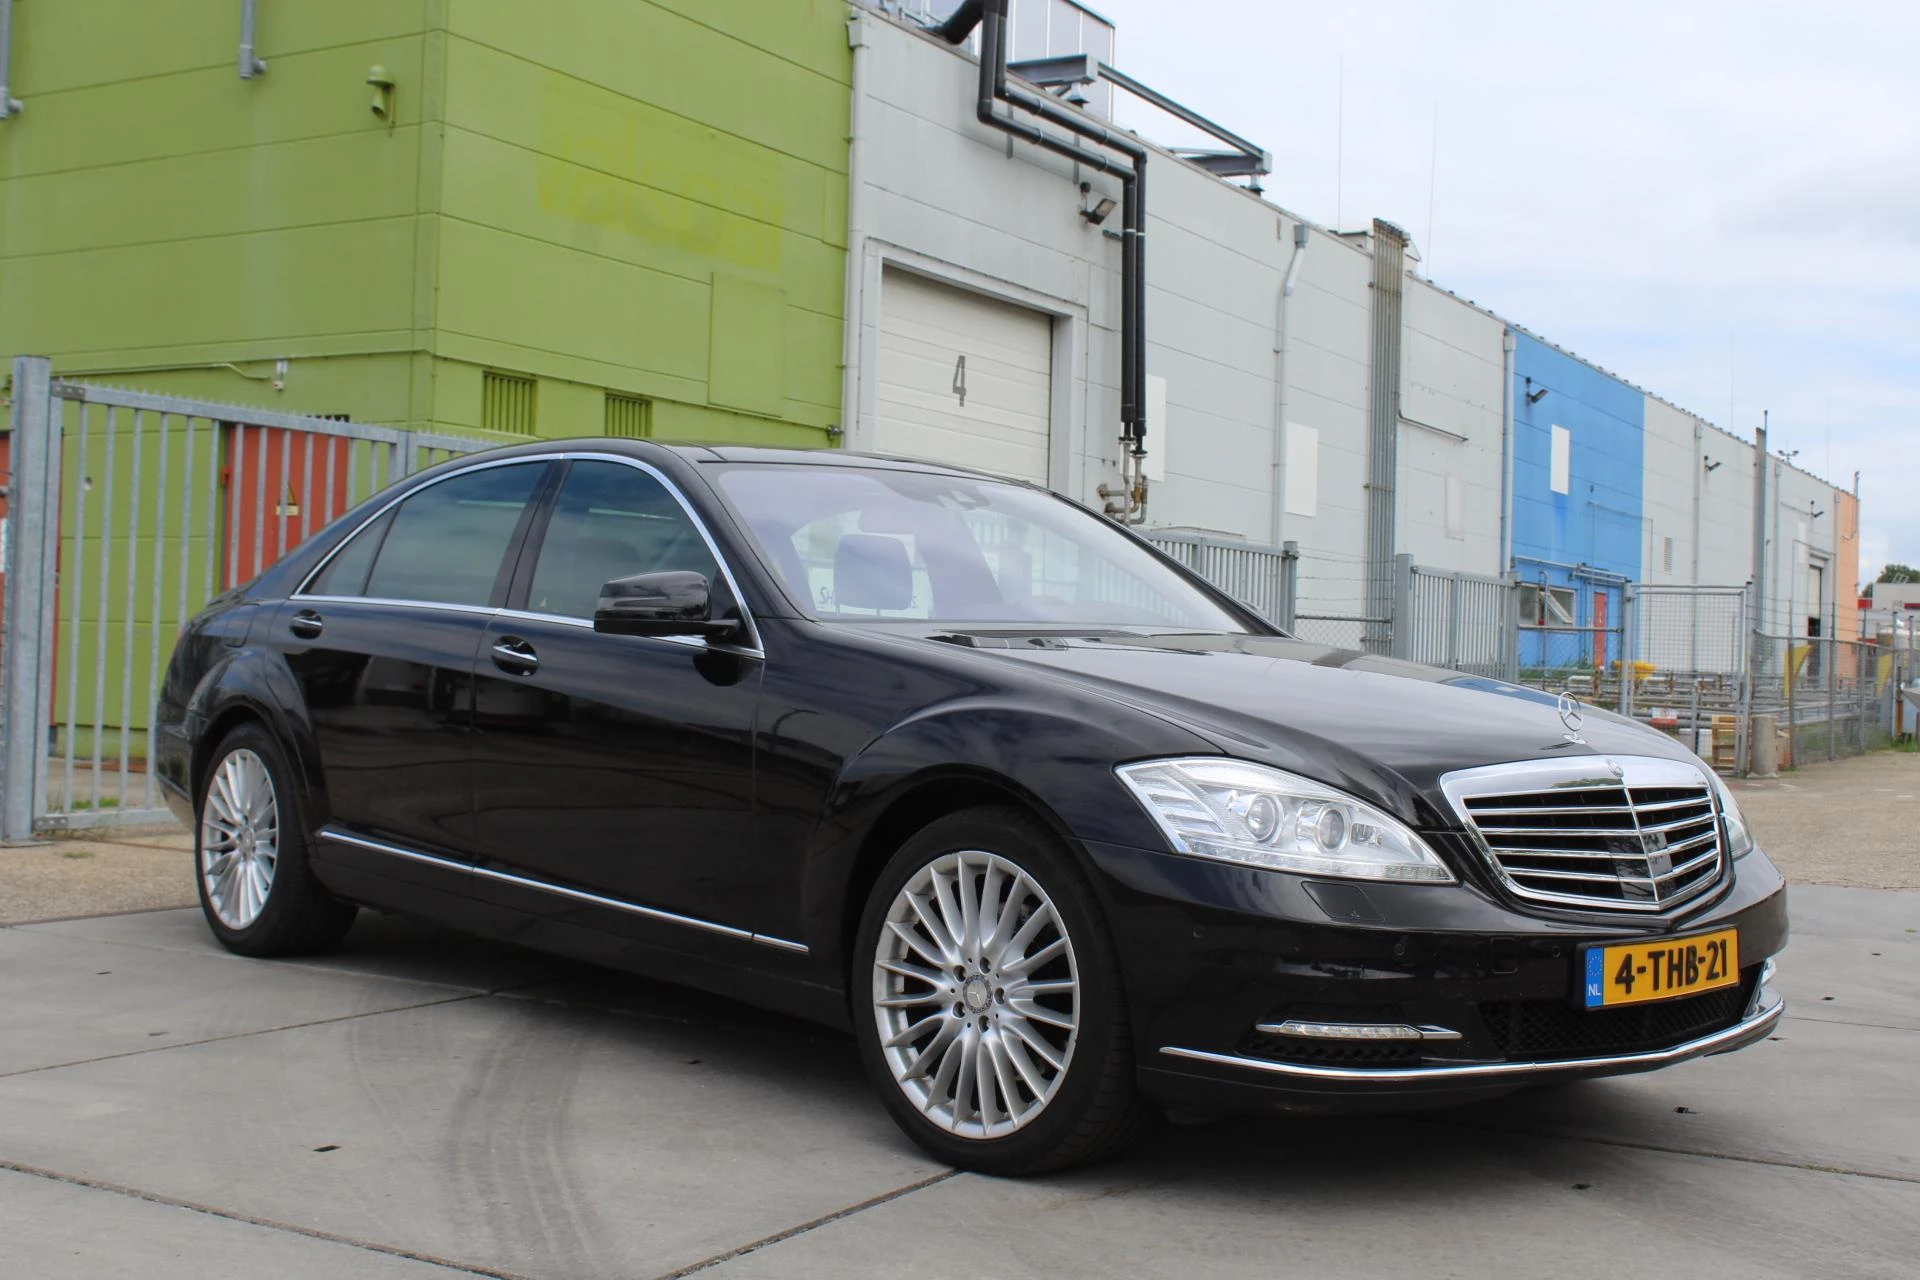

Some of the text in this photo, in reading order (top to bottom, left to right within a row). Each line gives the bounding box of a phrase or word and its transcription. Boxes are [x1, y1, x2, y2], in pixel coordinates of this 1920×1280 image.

[952, 354, 967, 407] 4
[1588, 983, 1601, 997] NL
[1615, 938, 1727, 994] 4-THB-21
